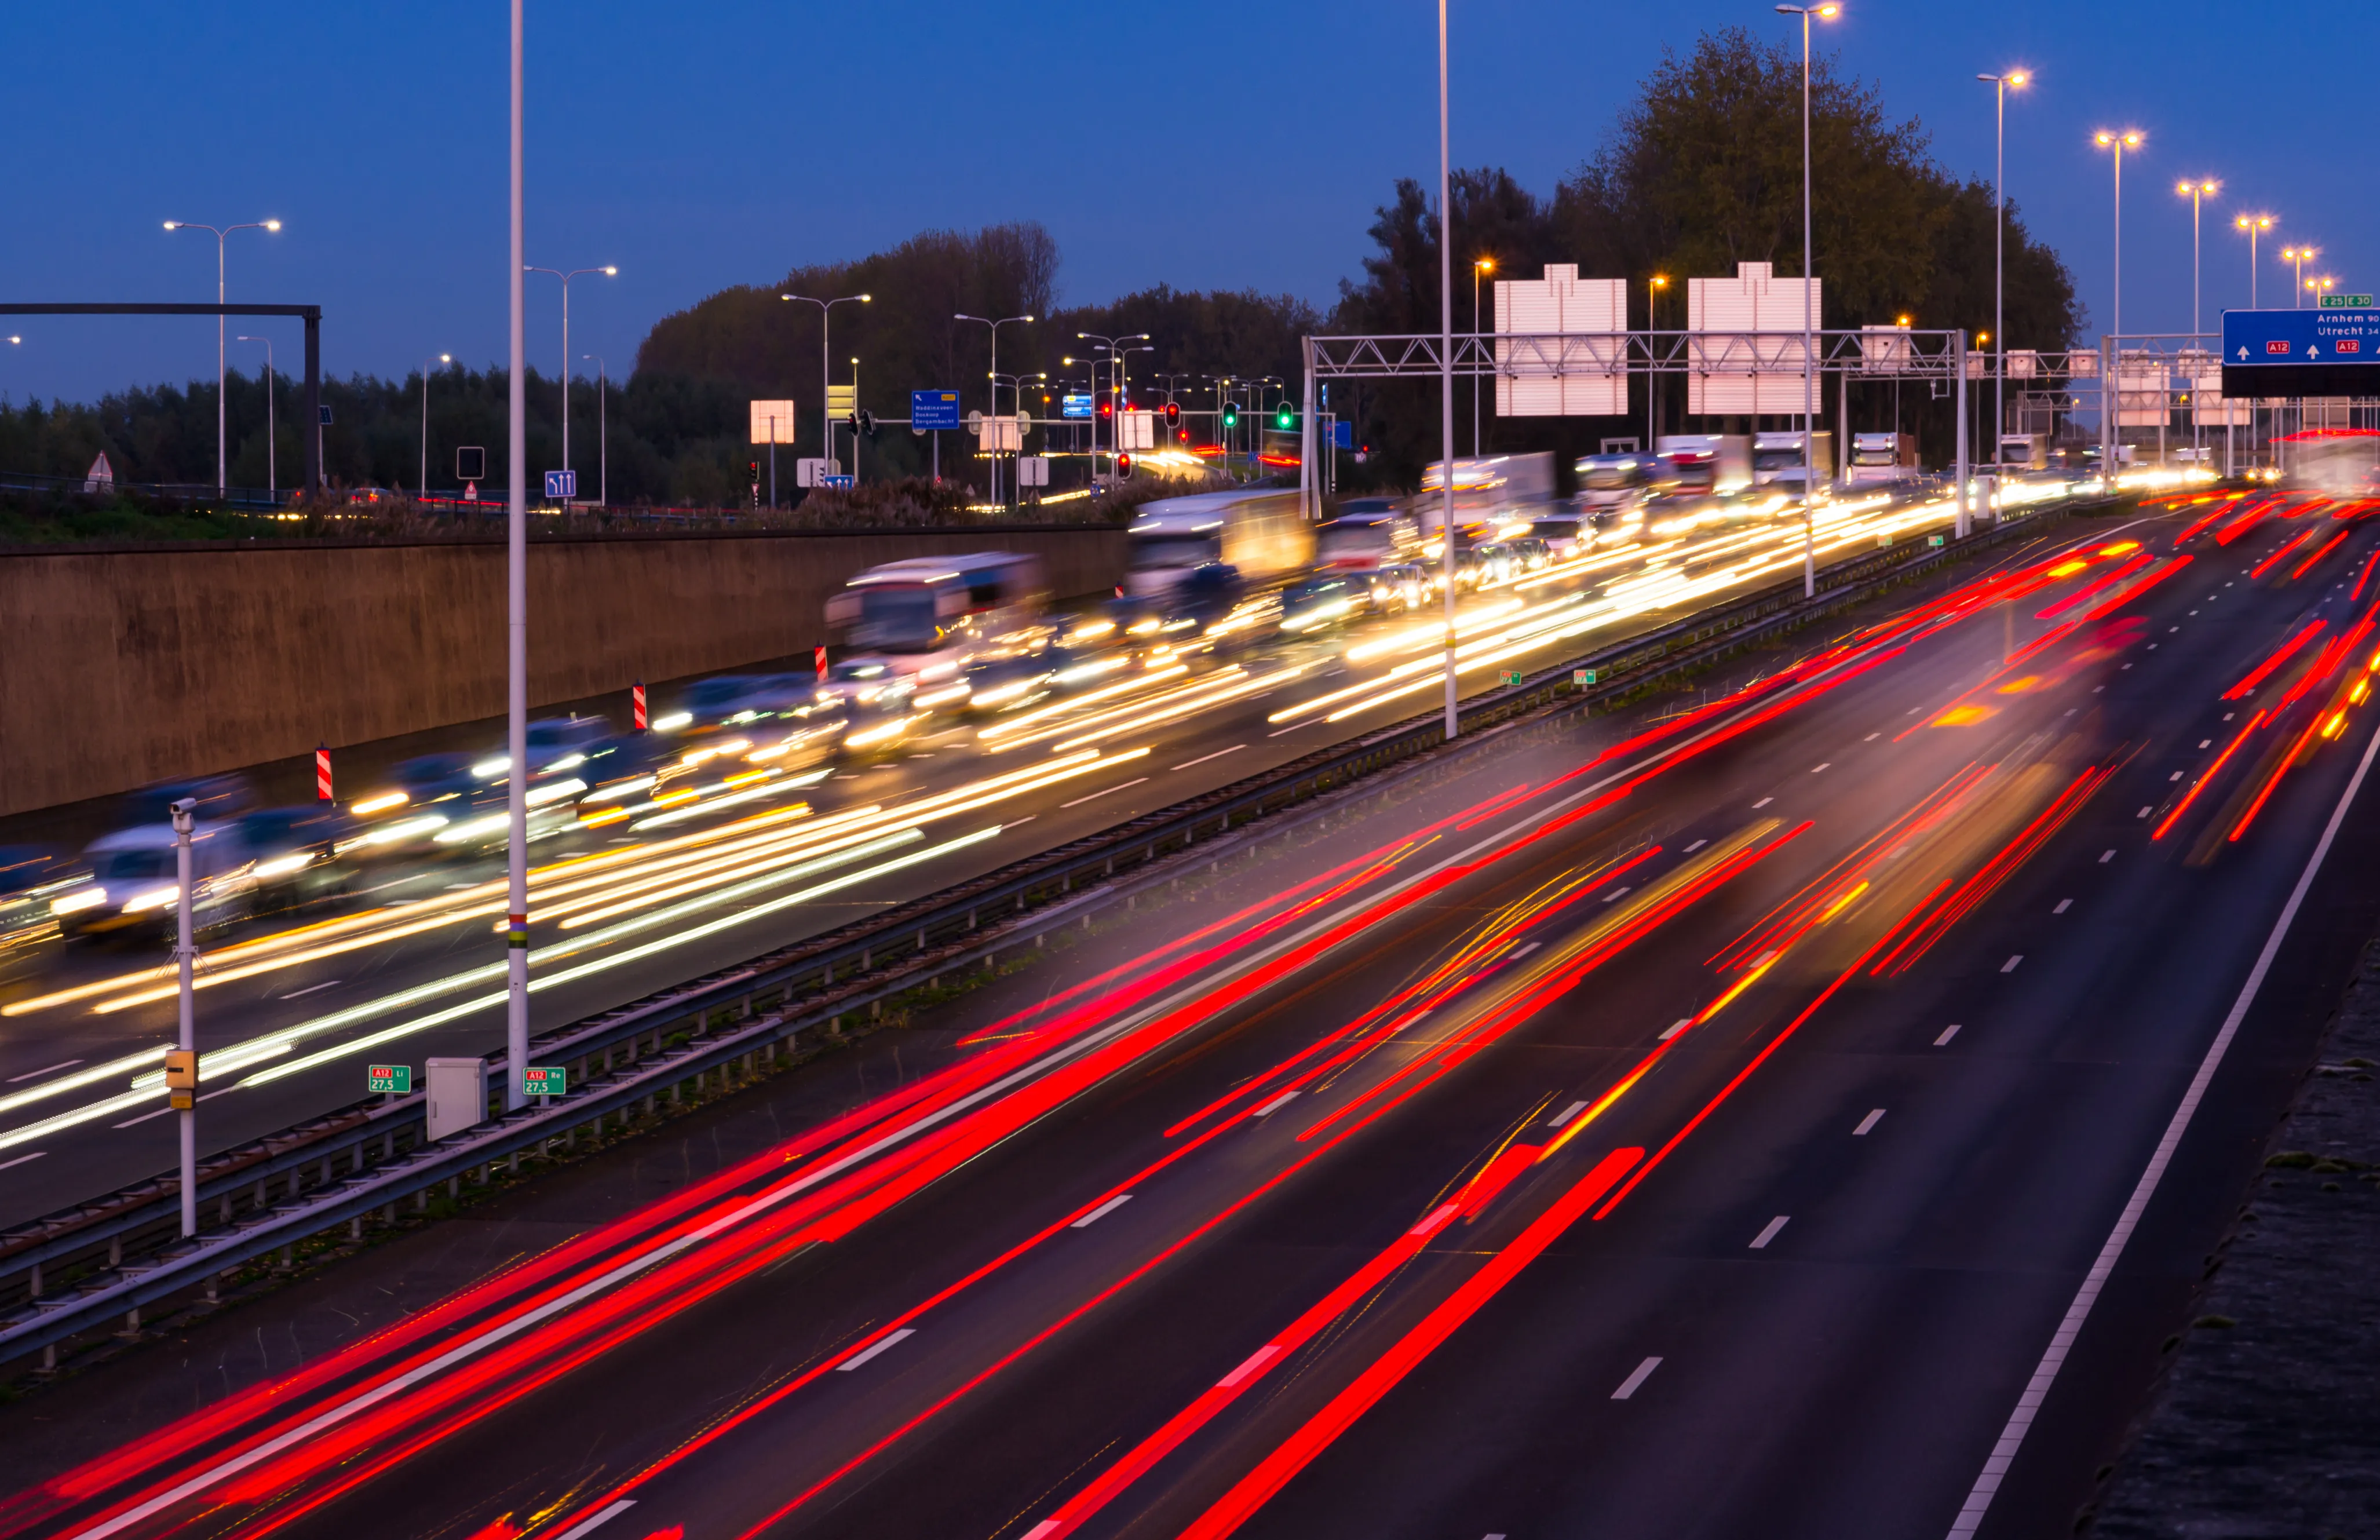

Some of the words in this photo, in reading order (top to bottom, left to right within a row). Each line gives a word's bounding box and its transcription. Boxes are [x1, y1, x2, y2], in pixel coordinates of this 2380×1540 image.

[2321, 297, 2328, 305] E
[2331, 297, 2344, 305] 25
[2348, 297, 2355, 305] E
[2357, 297, 2370, 305] 30
[2317, 314, 2364, 322] Arnhem
[2318, 327, 2363, 335] Utrecht
[2269, 344, 2288, 352] A12
[2339, 342, 2357, 351] A12
[372, 1079, 393, 1092] 27,5
[526, 1082, 548, 1094] 27,5
